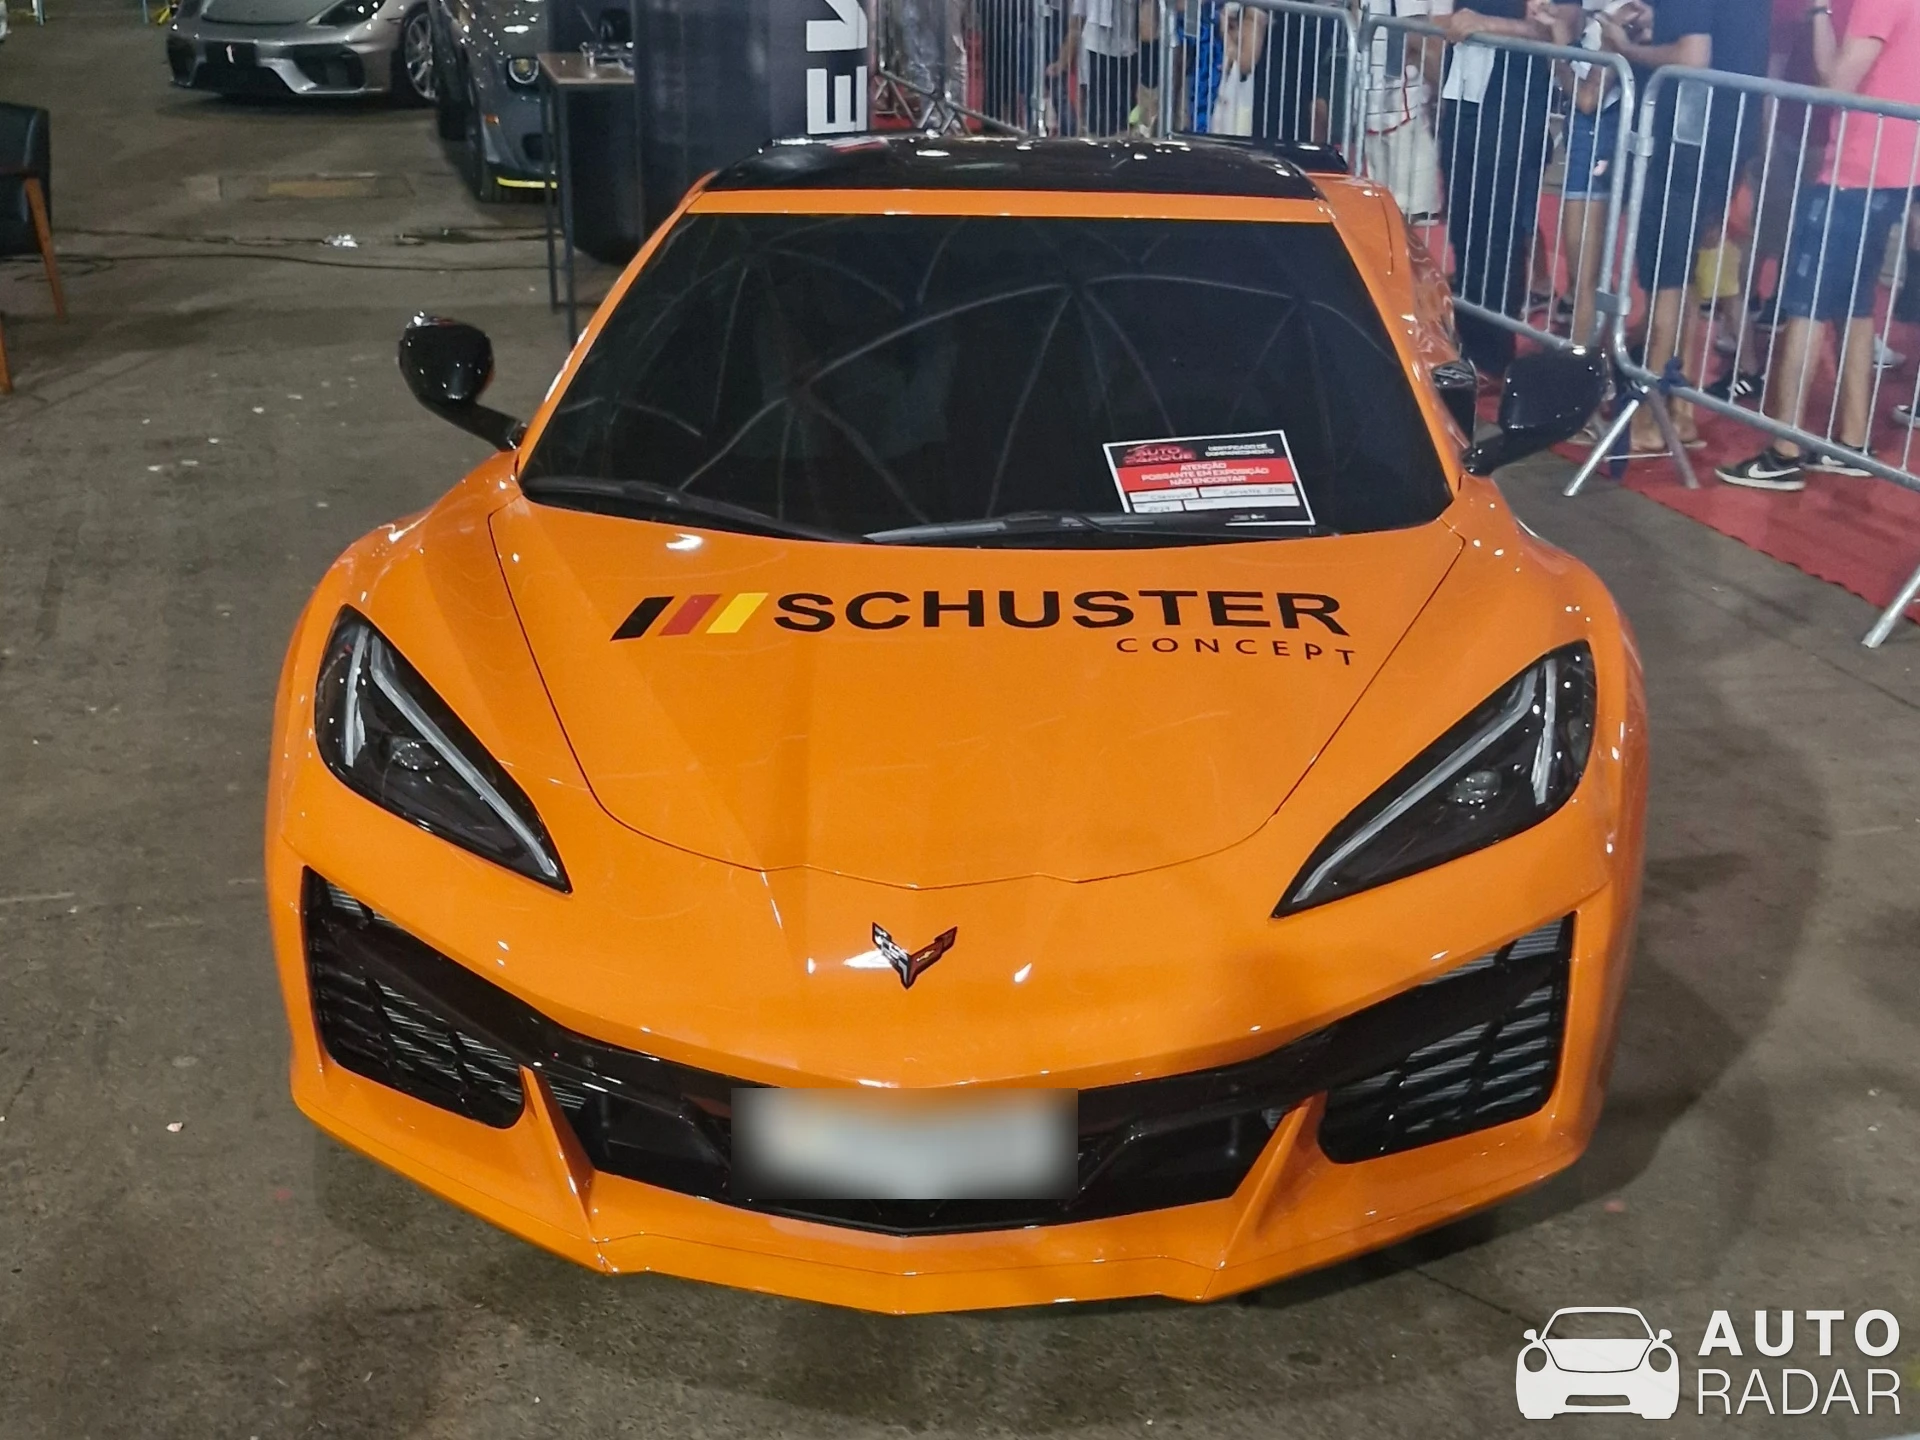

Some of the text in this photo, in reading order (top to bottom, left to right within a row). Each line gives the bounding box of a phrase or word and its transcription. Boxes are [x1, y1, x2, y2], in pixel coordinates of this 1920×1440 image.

[1141, 466, 1270, 482] POSSANTE EM EXPOSIÇÃO
[1180, 462, 1227, 472] ATENÇÃO
[1169, 475, 1247, 486] NÃO ENCOSTAR
[774, 590, 1349, 637] SCHUSTER
[1116, 638, 1354, 666] CONCEPT
